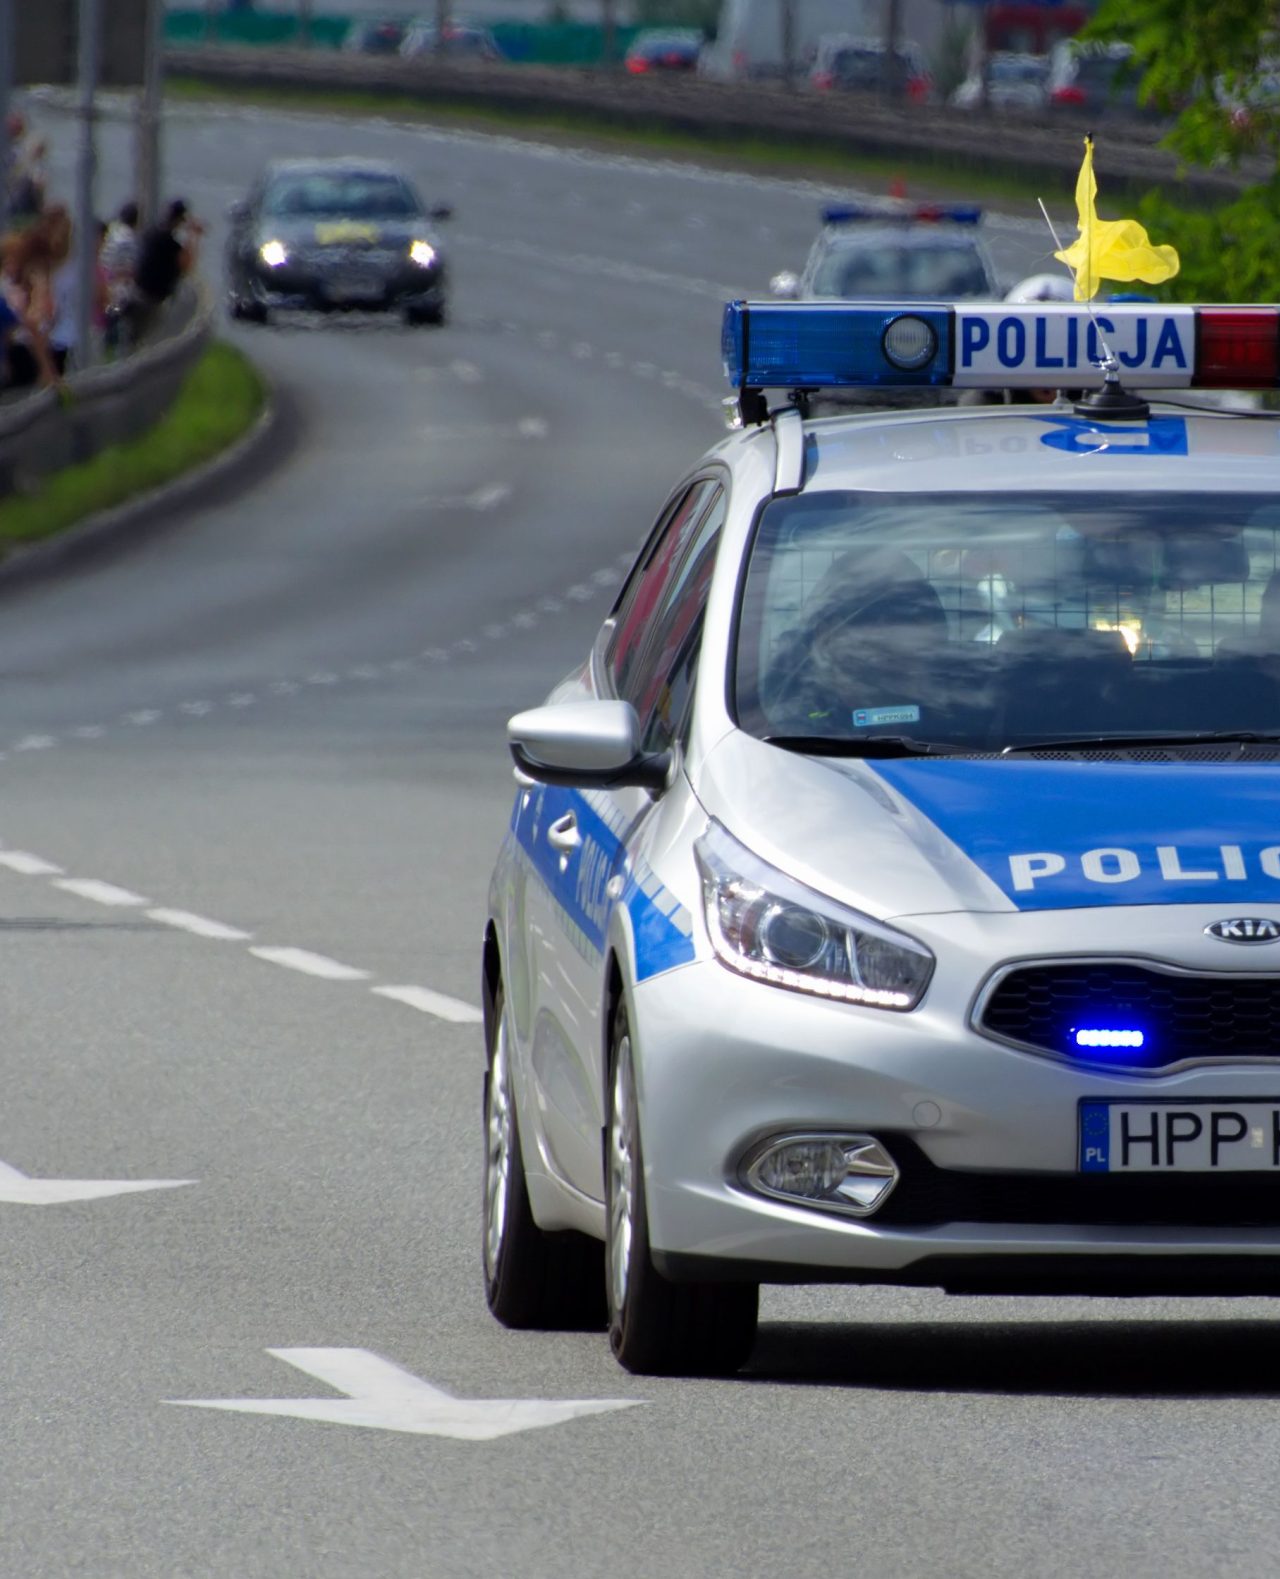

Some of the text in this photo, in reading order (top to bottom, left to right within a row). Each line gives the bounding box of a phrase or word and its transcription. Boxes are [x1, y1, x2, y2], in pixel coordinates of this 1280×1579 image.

[962, 317, 1187, 368] POLICJA
[1221, 919, 1279, 937] KIA
[1085, 1147, 1106, 1163] PL
[1121, 1111, 1248, 1167] HPP
